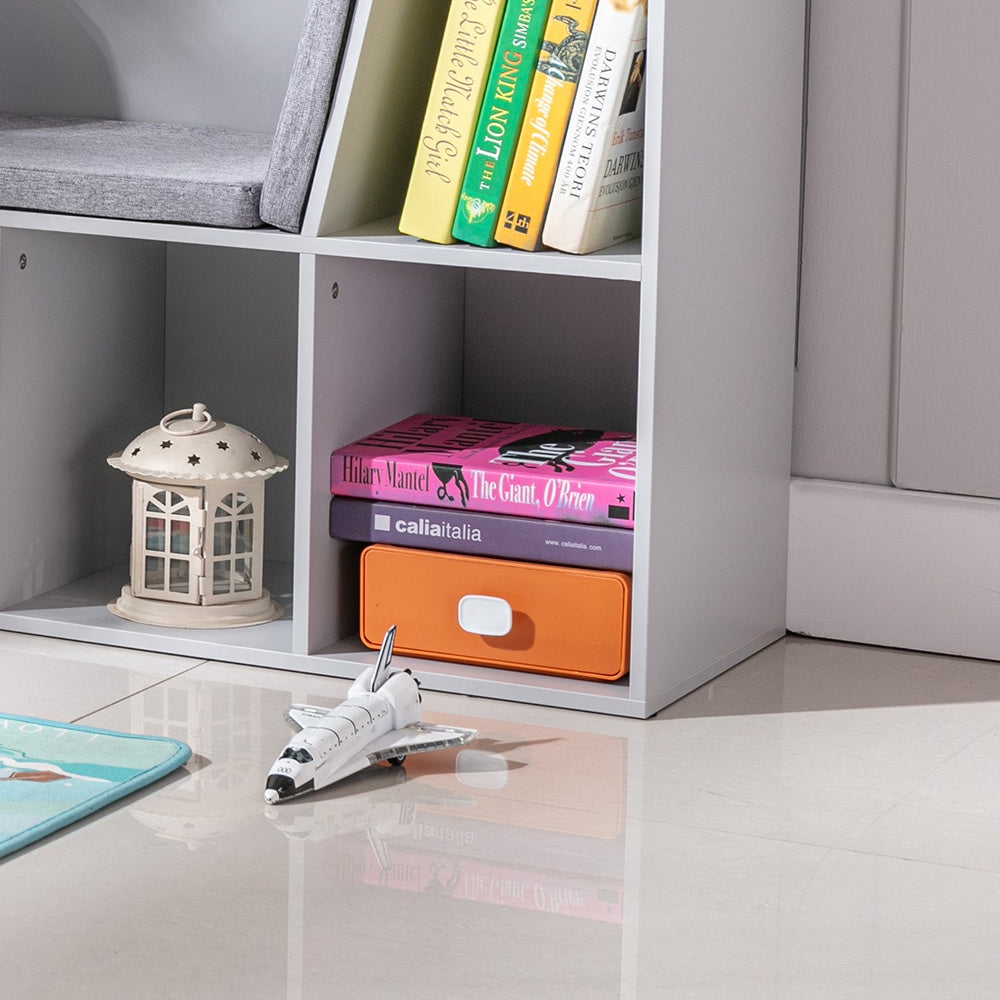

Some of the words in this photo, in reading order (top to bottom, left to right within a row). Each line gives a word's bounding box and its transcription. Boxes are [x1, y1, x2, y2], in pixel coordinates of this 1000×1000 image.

[450, 11, 487, 68] Little
[435, 69, 475, 139] Match
[494, 50, 523, 103] KING
[535, 67, 566, 119] Change
[584, 48, 617, 138] DARWINS
[422, 134, 459, 184] Girl
[475, 105, 510, 161] LION
[521, 131, 549, 187] Climate
[479, 160, 496, 190] THE
[569, 142, 594, 199] TEORI
[342, 454, 382, 495] Hilary
[385, 459, 430, 492] Mantel
[470, 469, 497, 500] The
[498, 472, 541, 508] Giant,
[543, 477, 596, 512] O'Brien
[395, 517, 482, 542] caliaitalia
